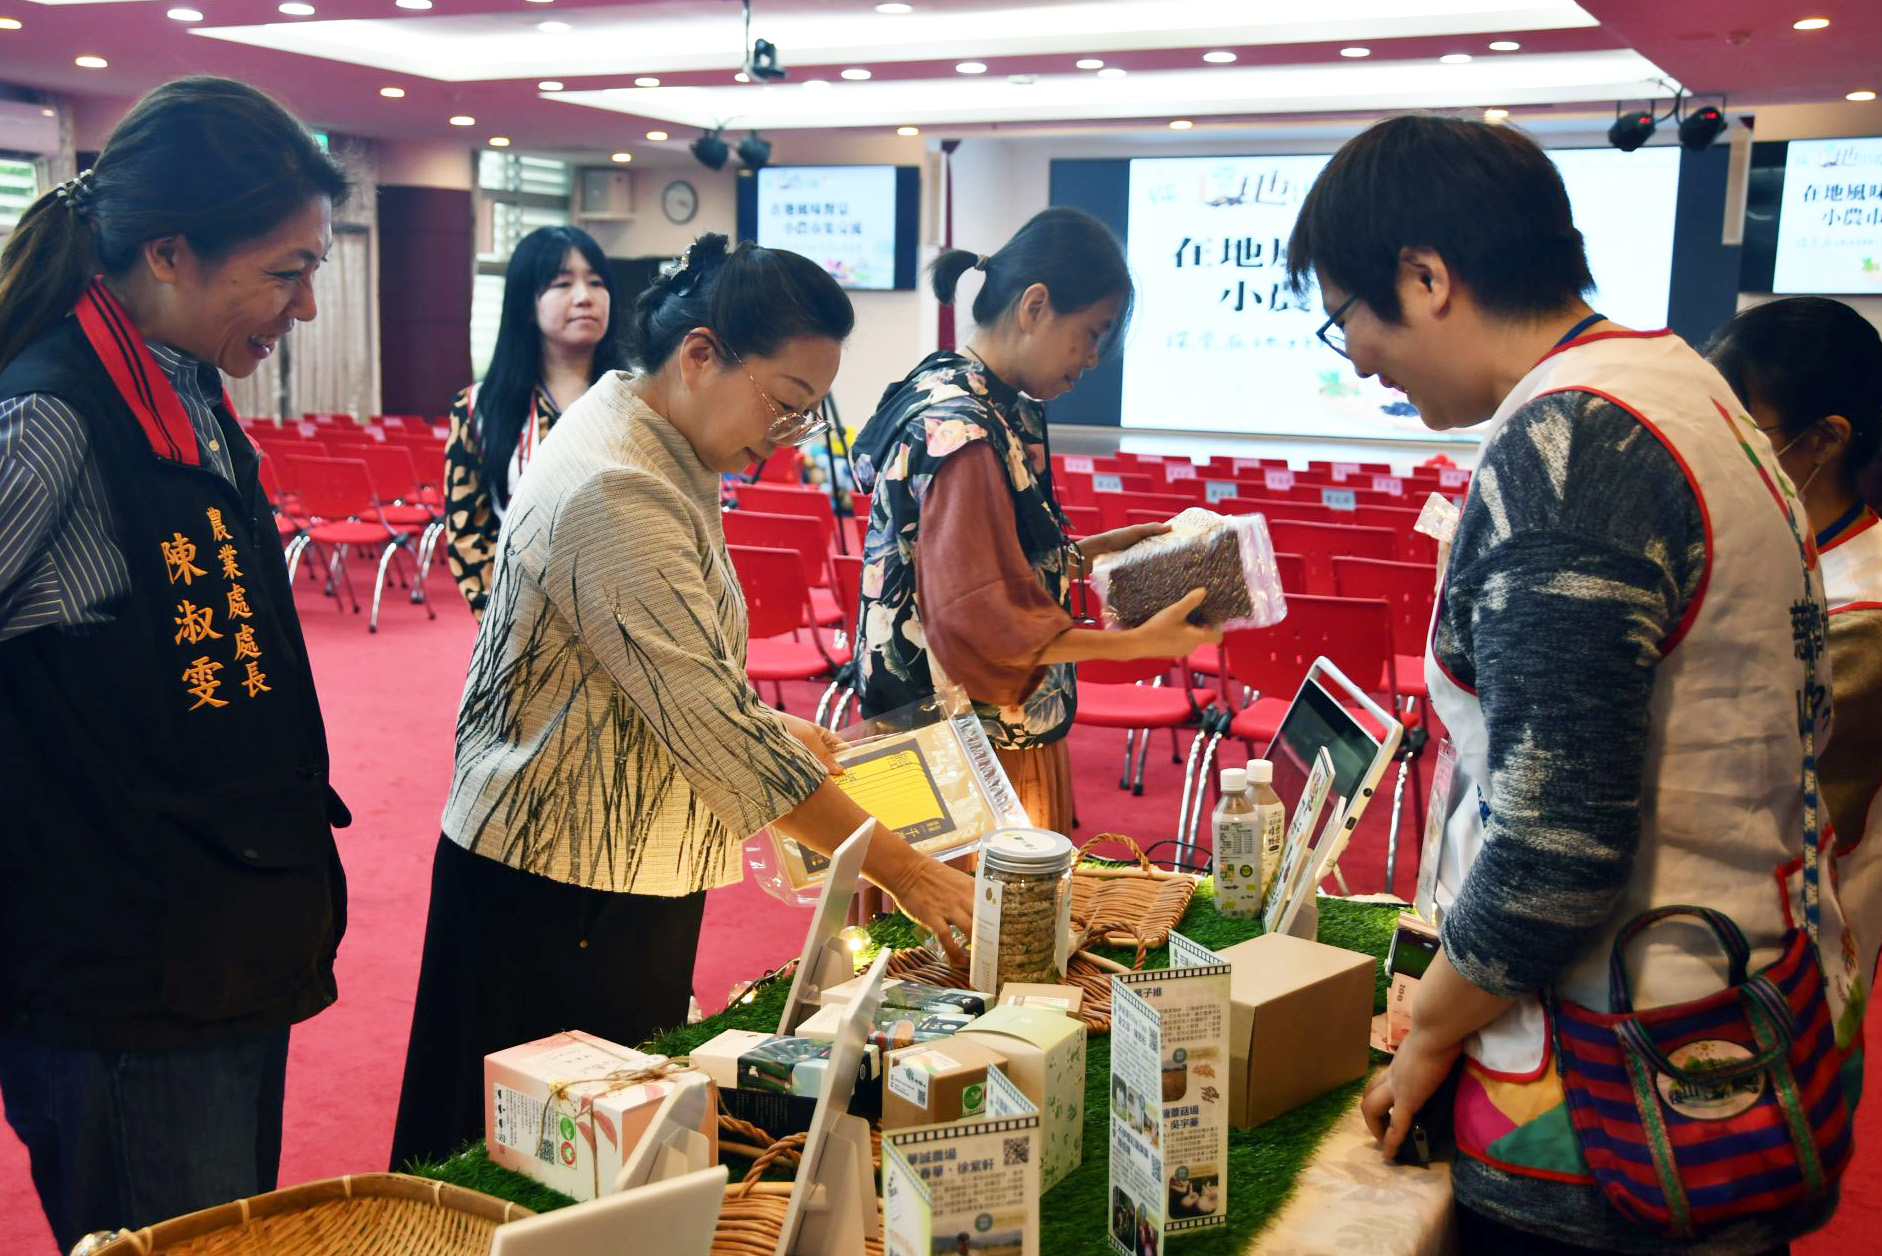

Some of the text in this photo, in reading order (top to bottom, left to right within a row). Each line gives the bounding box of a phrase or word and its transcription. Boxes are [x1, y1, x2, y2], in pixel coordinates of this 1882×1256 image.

[160, 532, 230, 712] 陳淑雯
[206, 506, 272, 698] 農業處處長
